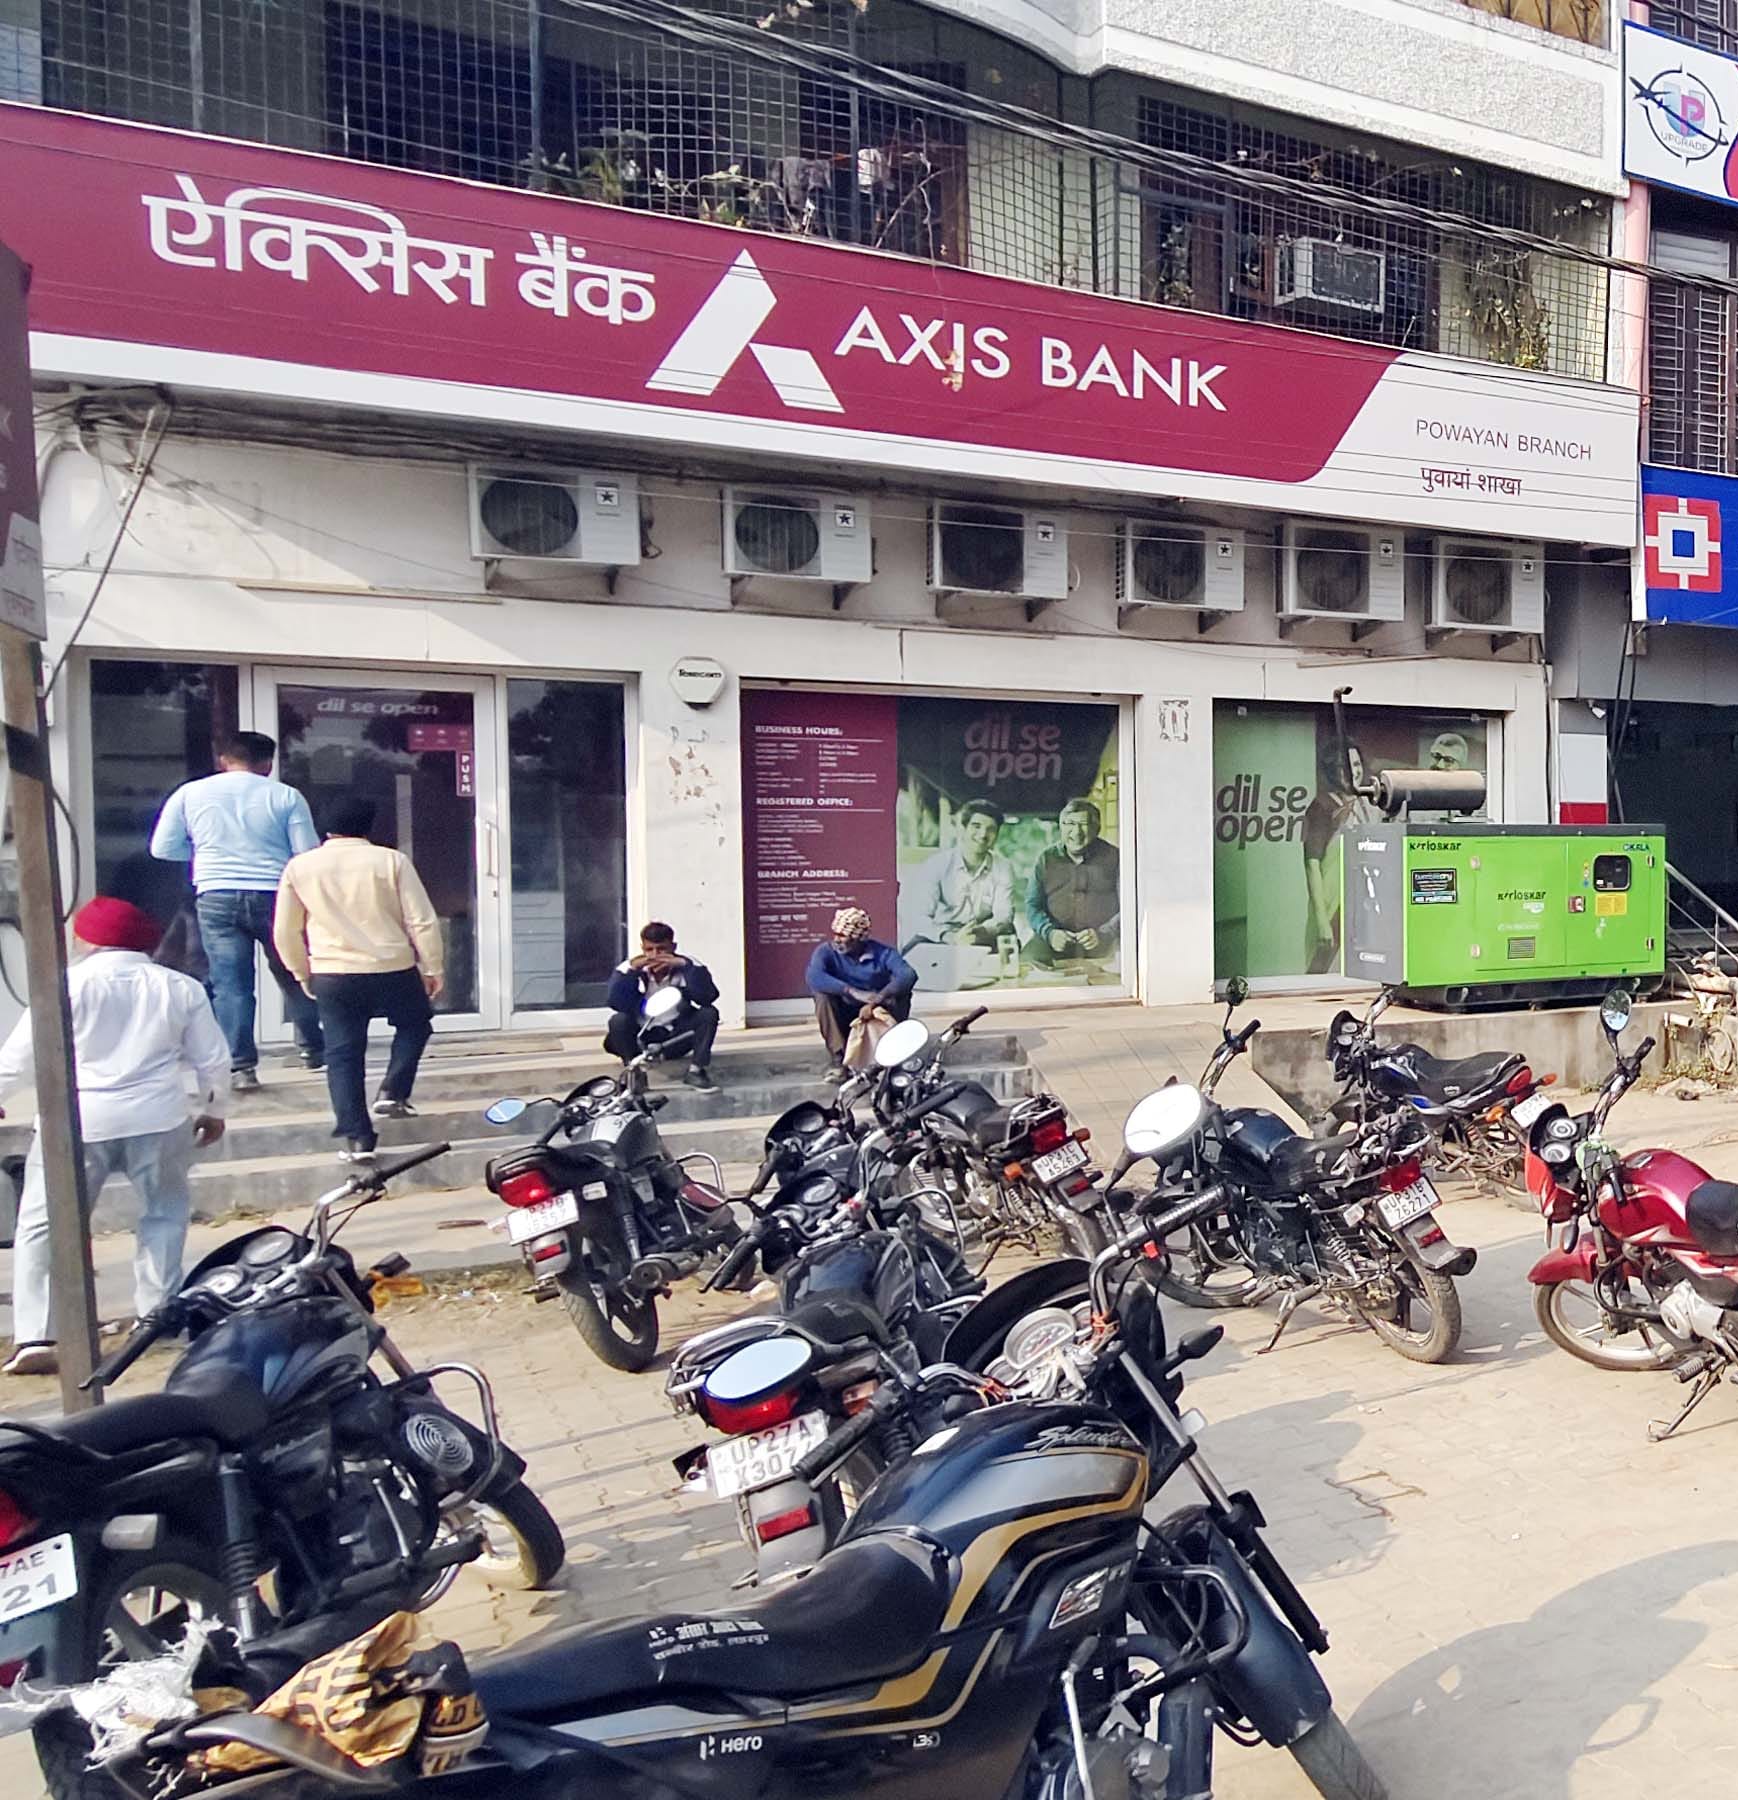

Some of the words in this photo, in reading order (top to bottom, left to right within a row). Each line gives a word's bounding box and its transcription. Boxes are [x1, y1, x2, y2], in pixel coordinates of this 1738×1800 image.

[516, 230, 657, 326] बैंक
[833, 304, 1010, 380] AXIS
[1041, 335, 1229, 413] BANK
[1416, 418, 1509, 449] POWAYAN
[1518, 434, 1592, 460] BRANCH
[1477, 473, 1522, 496] शाखा
[317, 697, 345, 712] dil
[350, 700, 376, 713] se
[380, 702, 439, 717] open
[964, 711, 1011, 750] dil
[1020, 724, 1060, 752] se
[963, 751, 1062, 786] open
[1216, 773, 1262, 813] dil
[1267, 785, 1308, 813] se
[1215, 814, 1307, 850] open
[730, 1419, 812, 1465] UP27A
